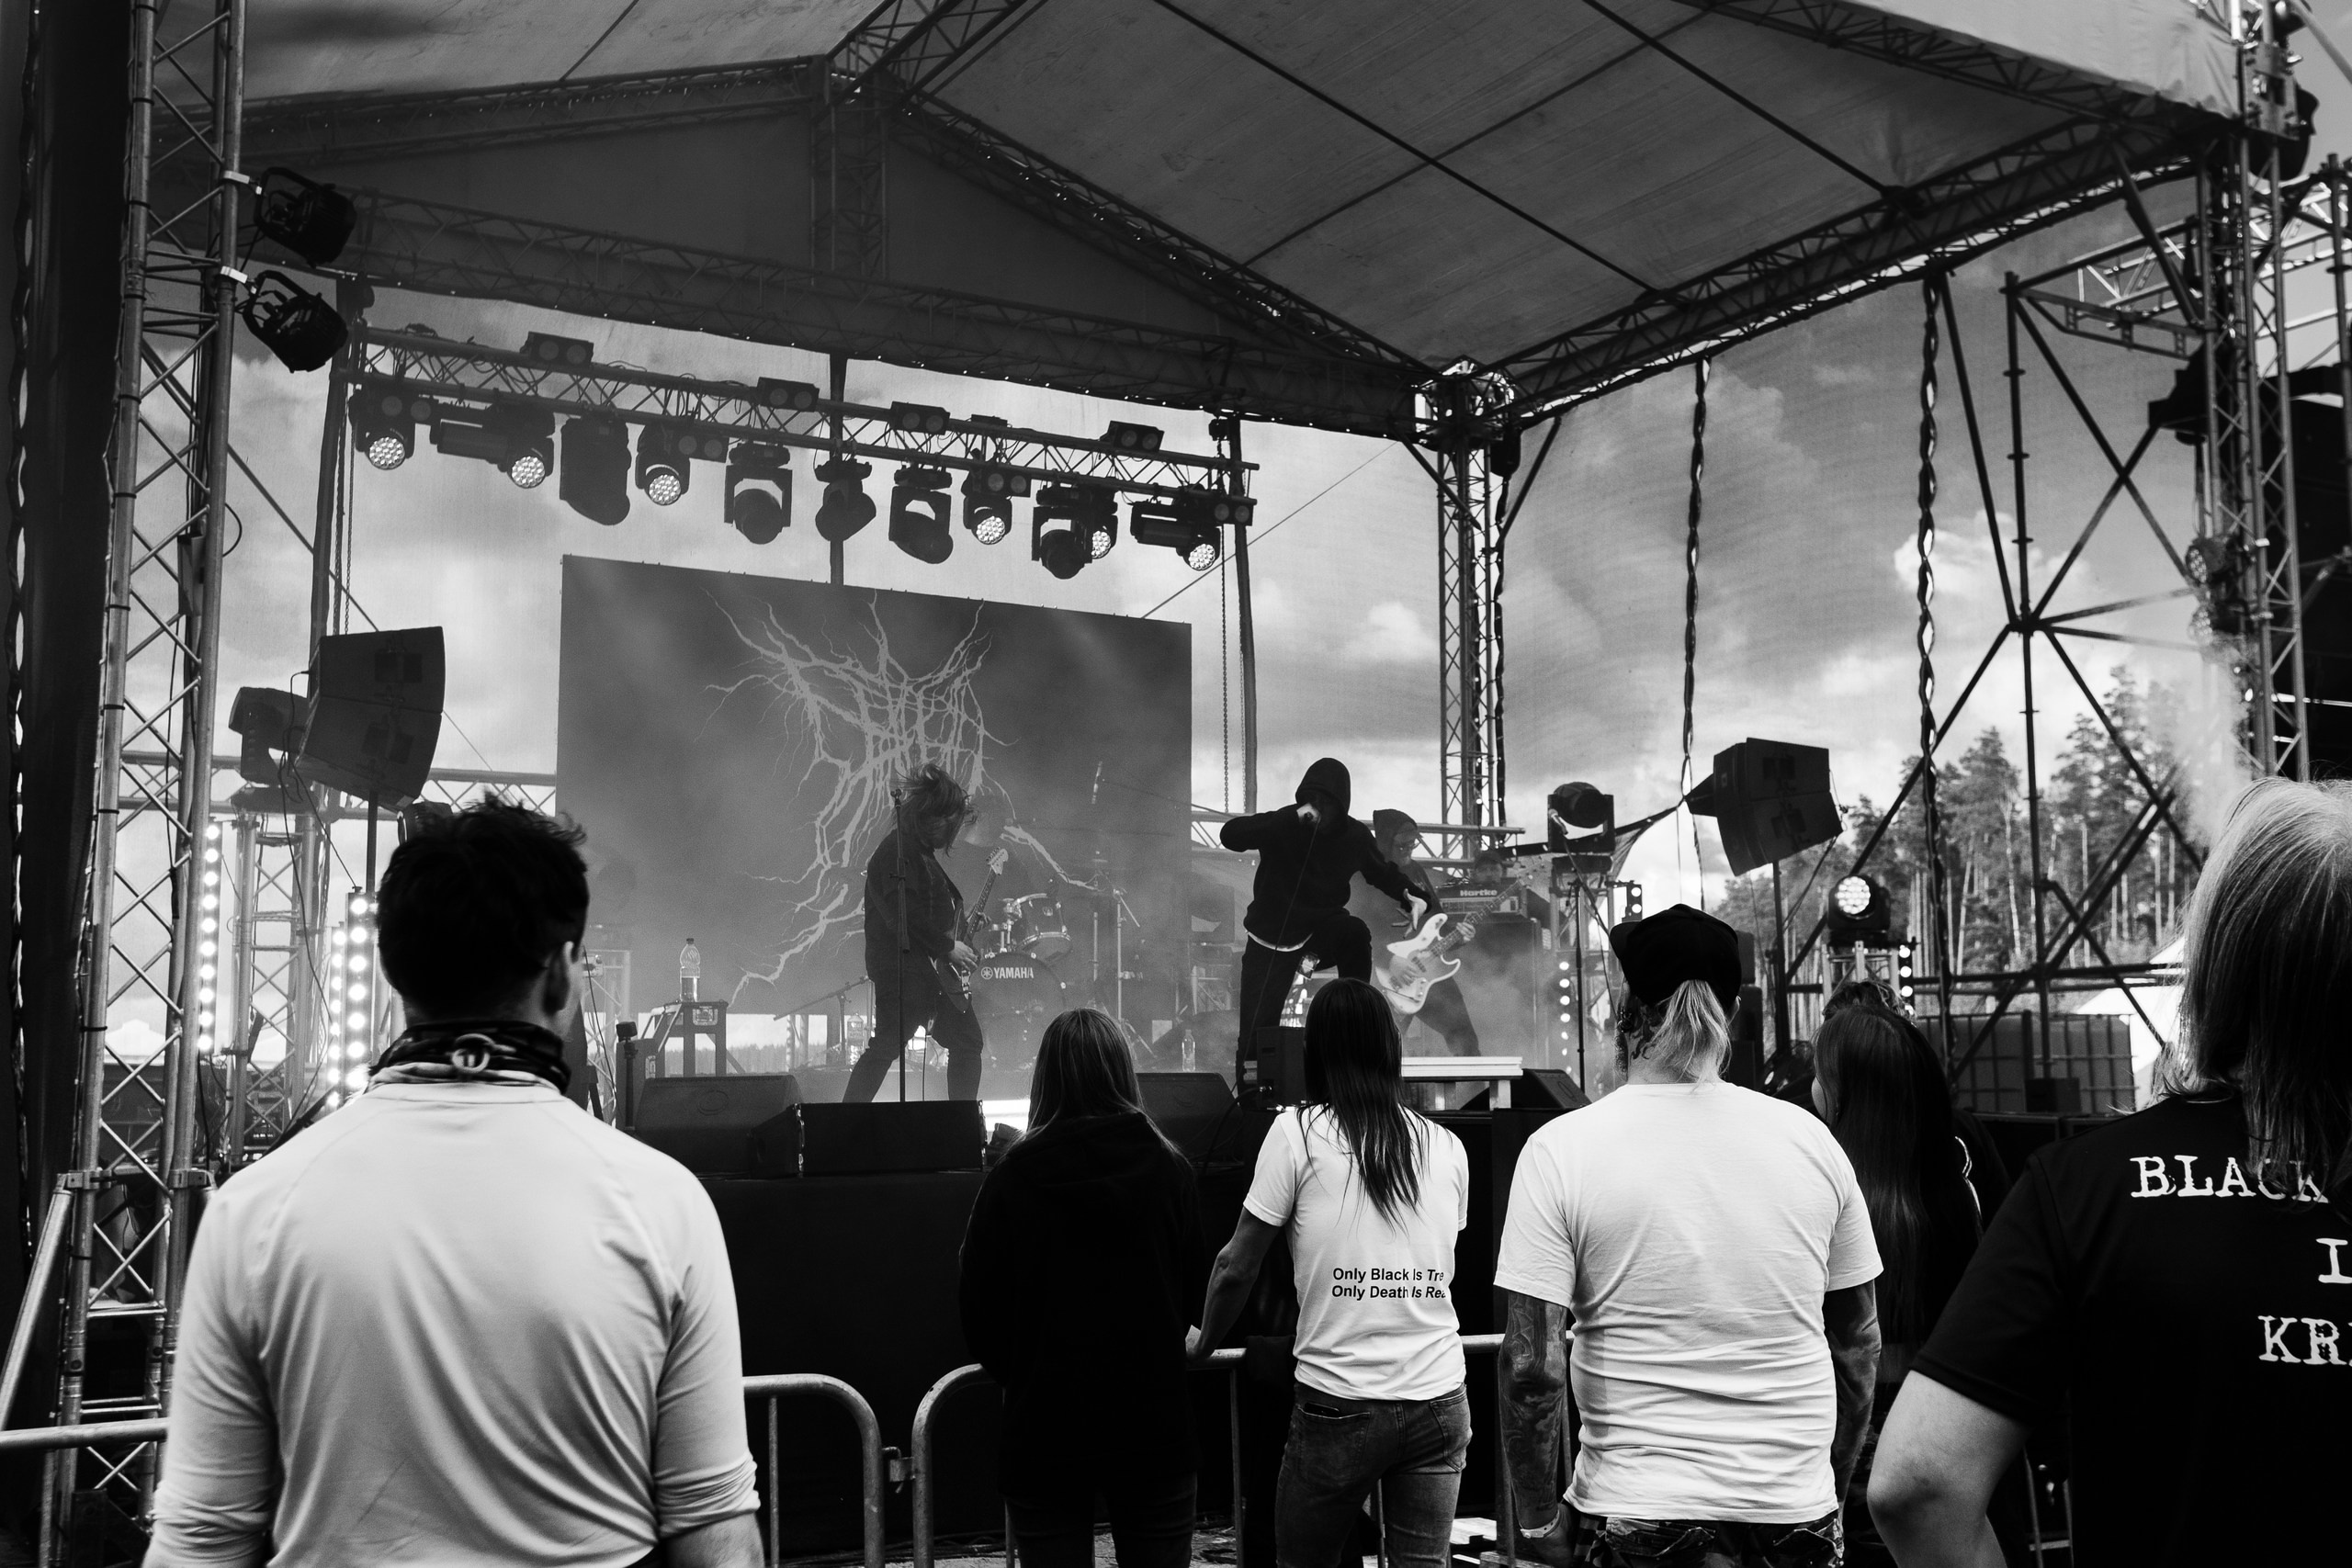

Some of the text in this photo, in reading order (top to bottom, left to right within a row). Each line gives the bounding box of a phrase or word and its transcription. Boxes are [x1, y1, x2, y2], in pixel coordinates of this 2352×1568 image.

[993, 967, 1035, 979] YAMAHA
[2130, 1155, 2329, 1203] BLACK
[1333, 1268, 1366, 1283] Only
[1371, 1269, 1409, 1280] Black
[1413, 1269, 1422, 1280] Is
[1332, 1285, 1365, 1301] Only
[1370, 1286, 1409, 1298] Death
[1411, 1286, 1422, 1298] Is
[2257, 1314, 2352, 1367] KR
